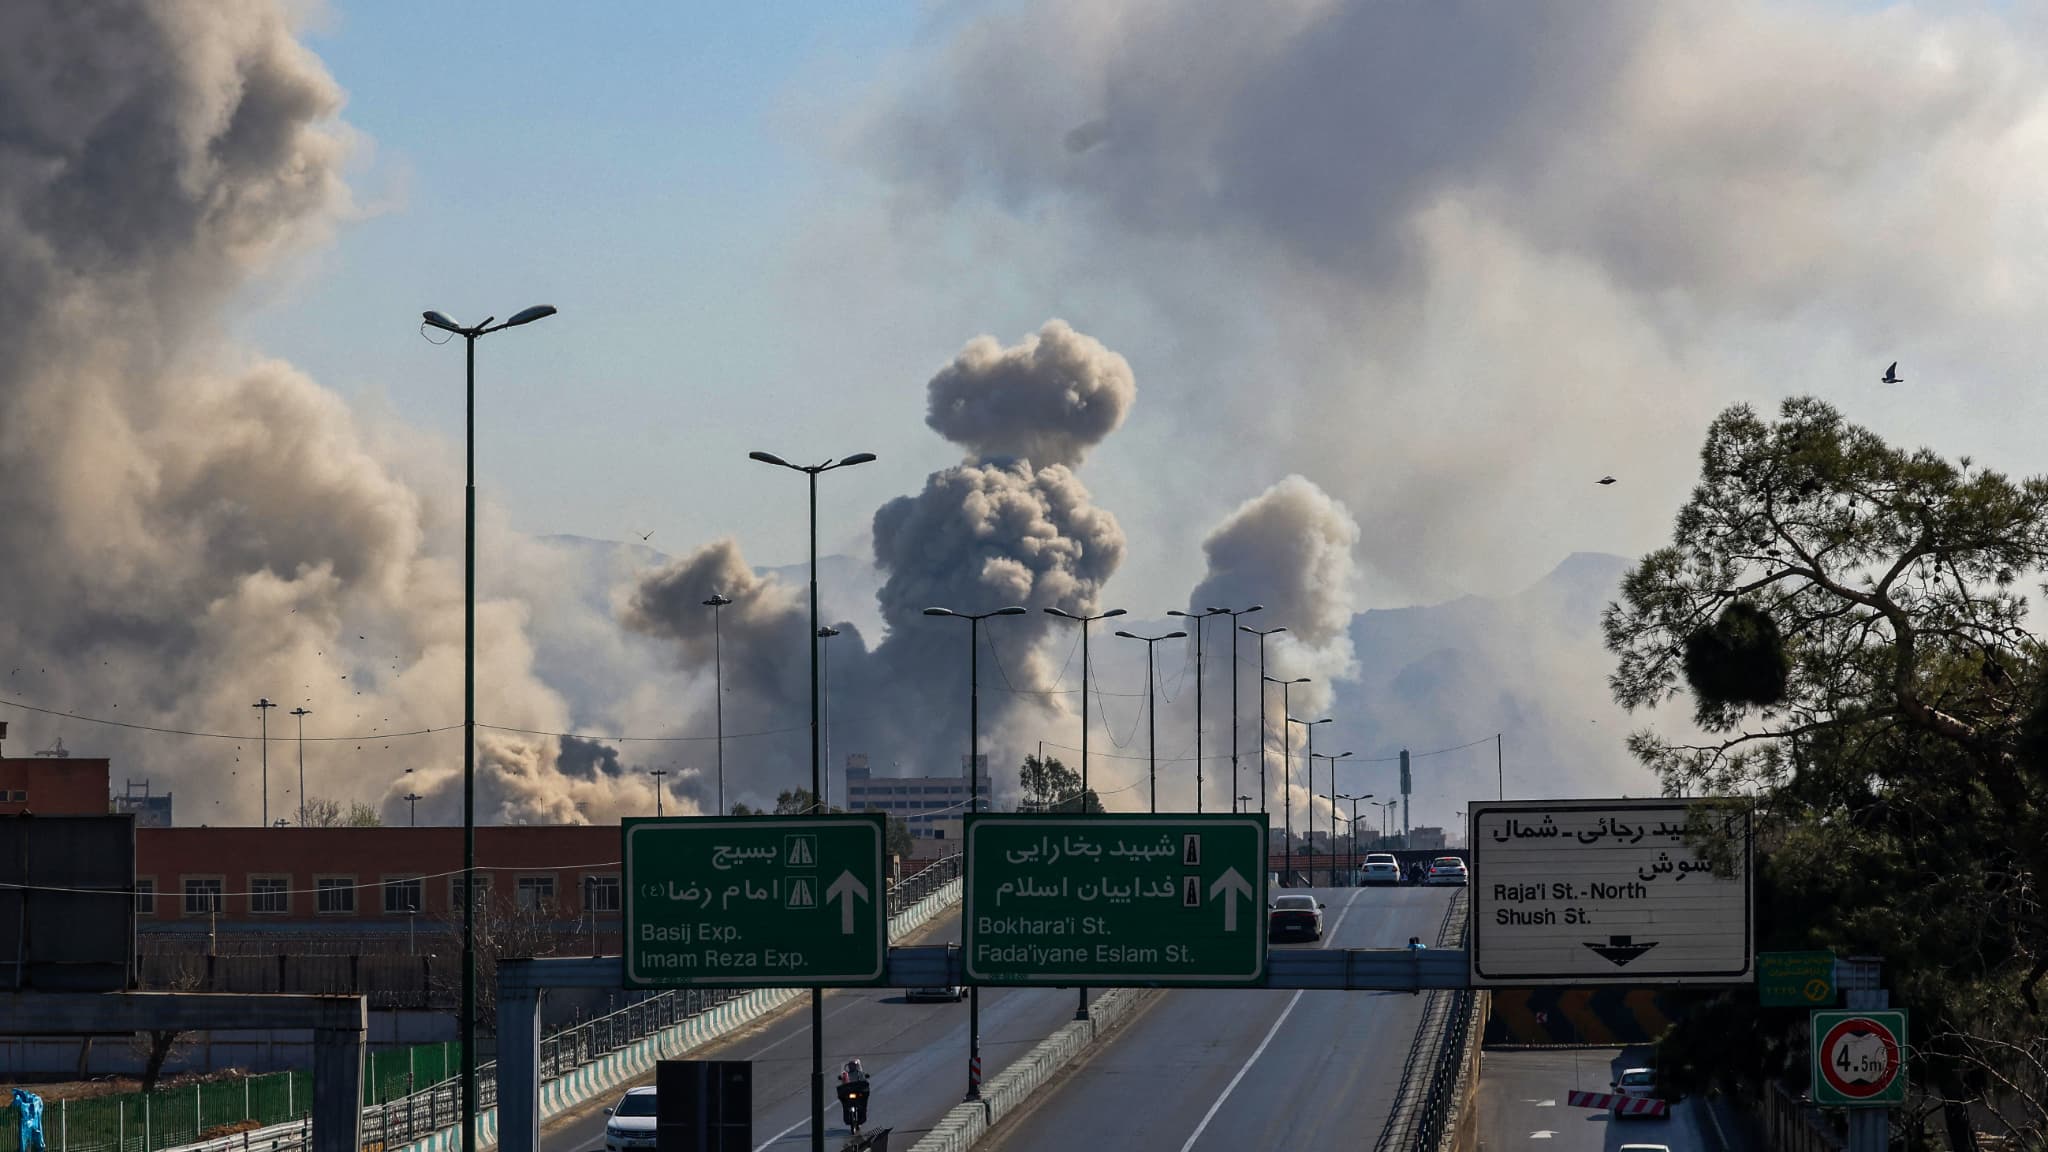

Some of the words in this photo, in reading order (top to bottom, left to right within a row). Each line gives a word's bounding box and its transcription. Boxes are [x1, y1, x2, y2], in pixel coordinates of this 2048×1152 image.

[712, 845, 778, 870] بسیج
[1006, 834, 1102, 865] بخارایی
[1109, 834, 1176, 862] شهید
[669, 879, 713, 910] رضا
[723, 879, 779, 910] امام
[995, 876, 1068, 906] اسلام
[1077, 874, 1176, 904] فداییان
[1494, 883, 1546, 904] Raja'i
[978, 916, 1075, 935] Bokhara'i
[1082, 917, 1112, 935] St.
[1496, 908, 1556, 925] Shush
[1564, 907, 1592, 925] St.
[641, 923, 691, 945] Basij
[698, 923, 742, 943] Exp.
[641, 951, 697, 969] Imam
[705, 950, 758, 967] Reza
[764, 949, 808, 970] Exp.
[978, 945, 1088, 966] Fada'iyane
[1096, 945, 1158, 963] Eslam
[1165, 945, 1195, 963] St.
